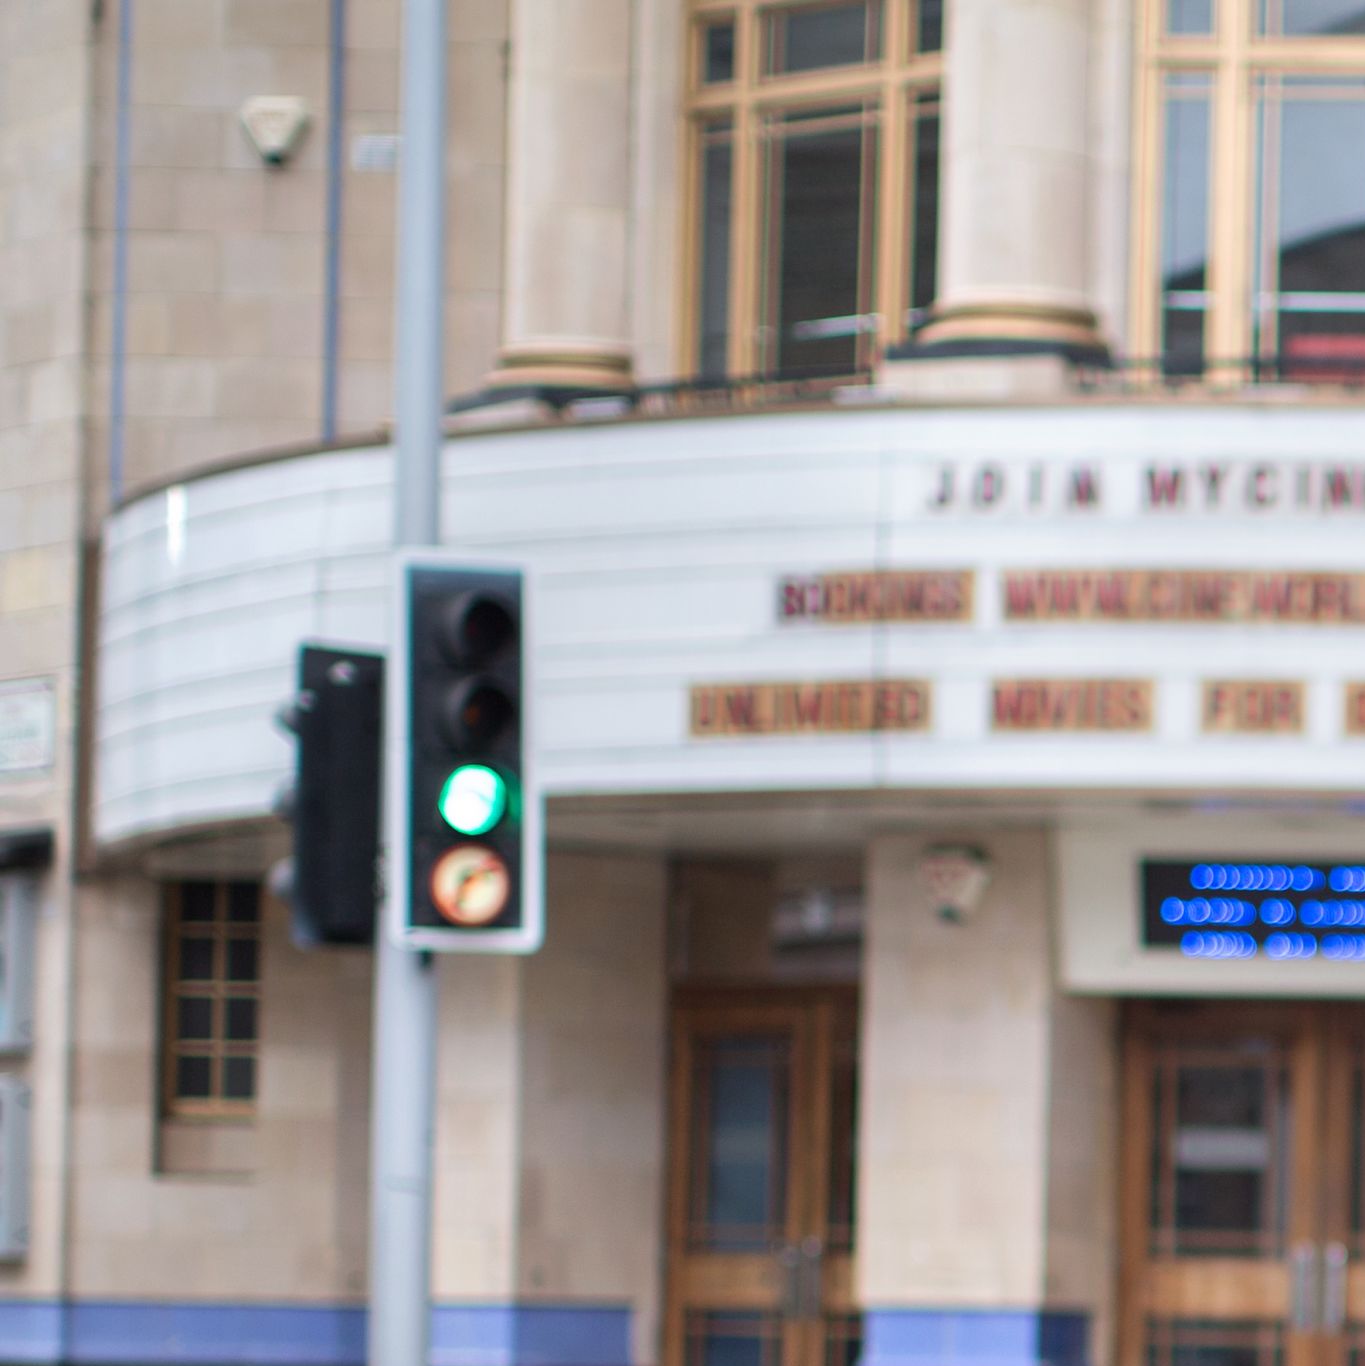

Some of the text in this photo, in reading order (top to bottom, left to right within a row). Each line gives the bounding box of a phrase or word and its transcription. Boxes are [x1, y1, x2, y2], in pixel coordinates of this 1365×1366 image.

[927, 462, 1101, 511] JOIN
[691, 682, 931, 734] UNLIMITED
[992, 679, 1152, 731] MOVIES
[1203, 680, 1304, 733] FOR
